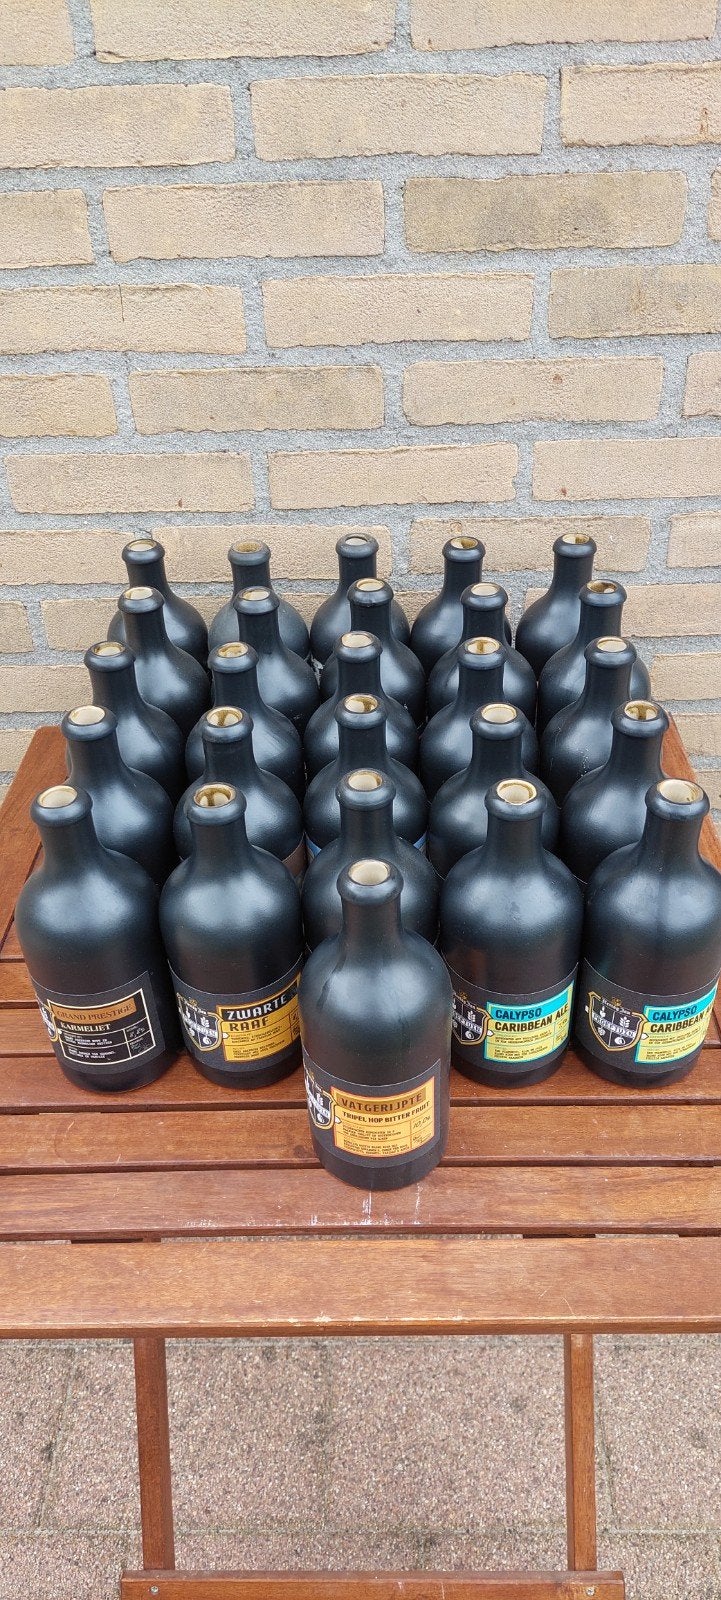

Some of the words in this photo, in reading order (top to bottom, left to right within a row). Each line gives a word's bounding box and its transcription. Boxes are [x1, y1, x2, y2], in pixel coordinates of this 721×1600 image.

[56, 1009, 87, 1021] GRAND
[88, 1003, 133, 1021] PRESTIGE
[227, 994, 288, 1020] ZWARTE
[495, 1007, 542, 1020] CALYPSO
[652, 1005, 697, 1021] CALYPSO
[60, 1021, 111, 1032] KARMELIET
[229, 1016, 269, 1032] RAAF
[494, 1015, 553, 1032] CARIBBEAN
[555, 1004, 569, 1021] ALE
[650, 1011, 704, 1033] CARIBBEAN
[341, 1092, 423, 1113] VATGERIJPTE
[343, 1111, 366, 1123] TRIPEL
[385, 1112, 411, 1123] BITTER
[411, 1101, 431, 1116] FRUIT
